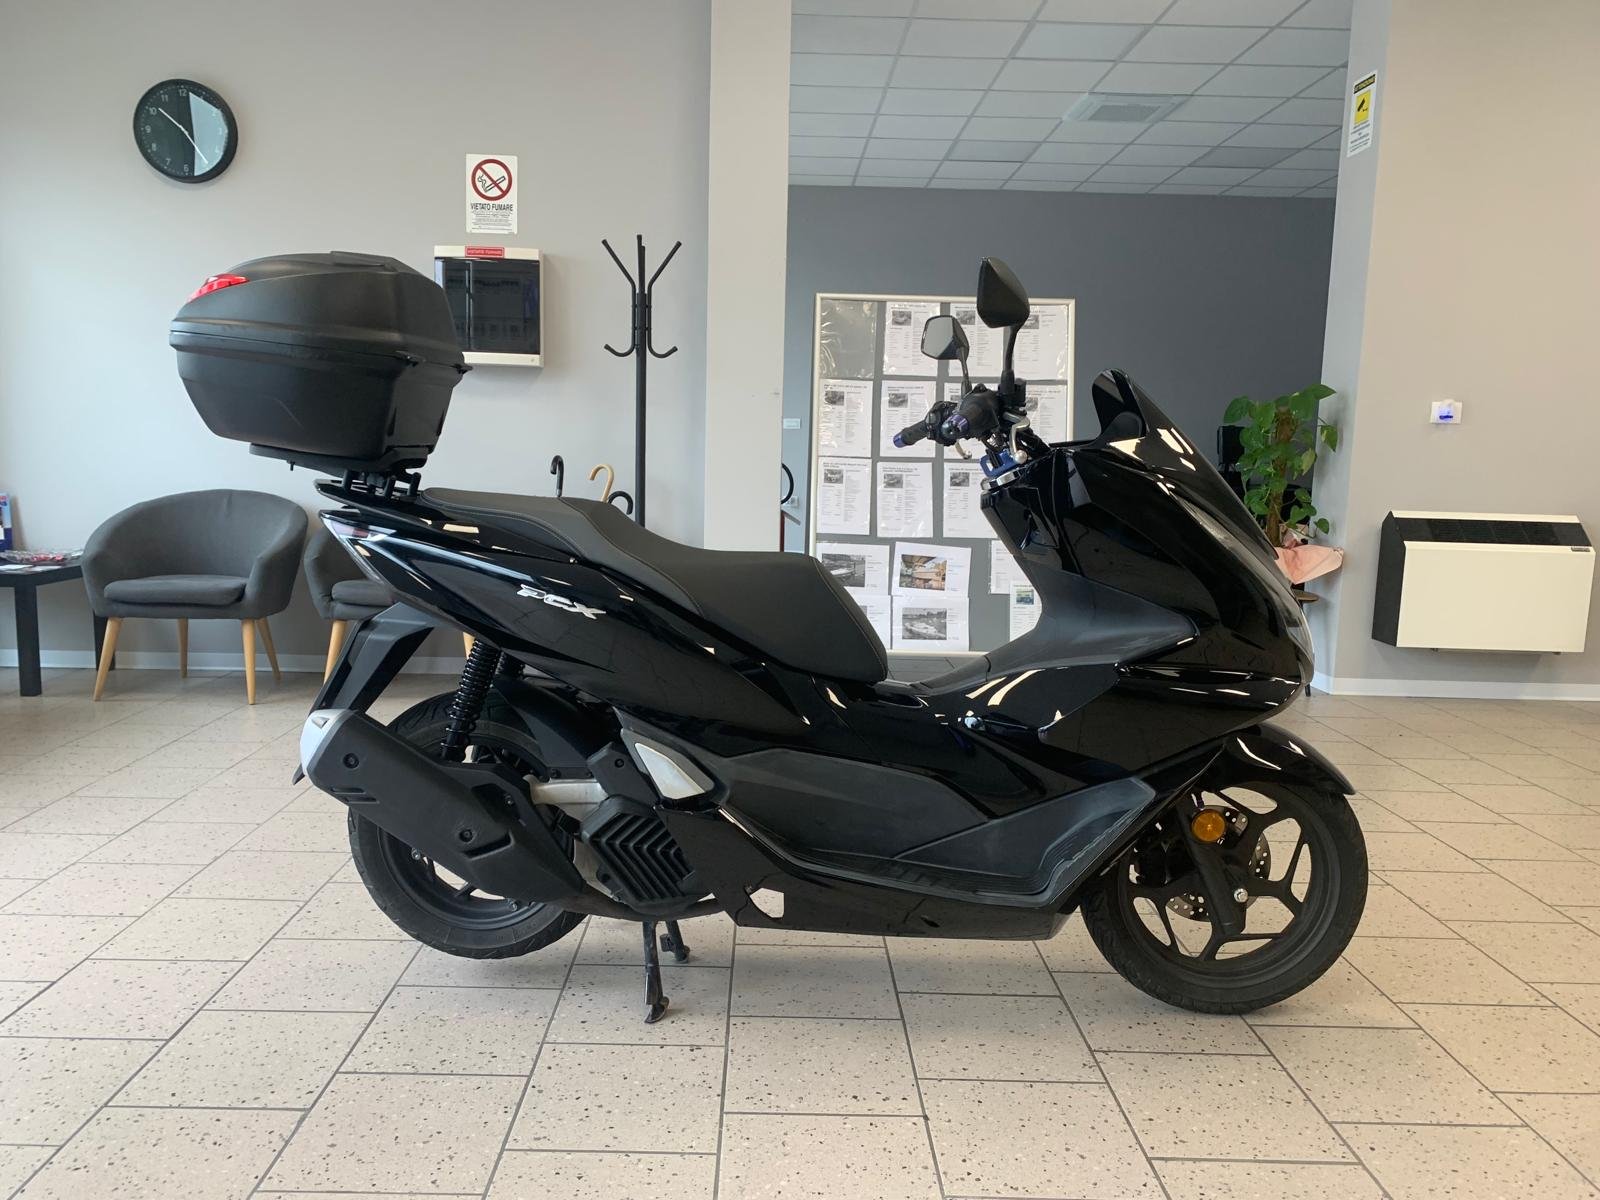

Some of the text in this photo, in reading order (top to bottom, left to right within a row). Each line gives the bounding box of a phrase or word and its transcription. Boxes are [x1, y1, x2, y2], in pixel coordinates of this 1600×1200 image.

[178, 89, 187, 97] 12
[149, 107, 157, 115] 10
[145, 126, 151, 134] 9
[165, 158, 171, 166] 7
[183, 164, 189, 172] 6
[470, 203, 513, 212] VIETATO FUMARE
